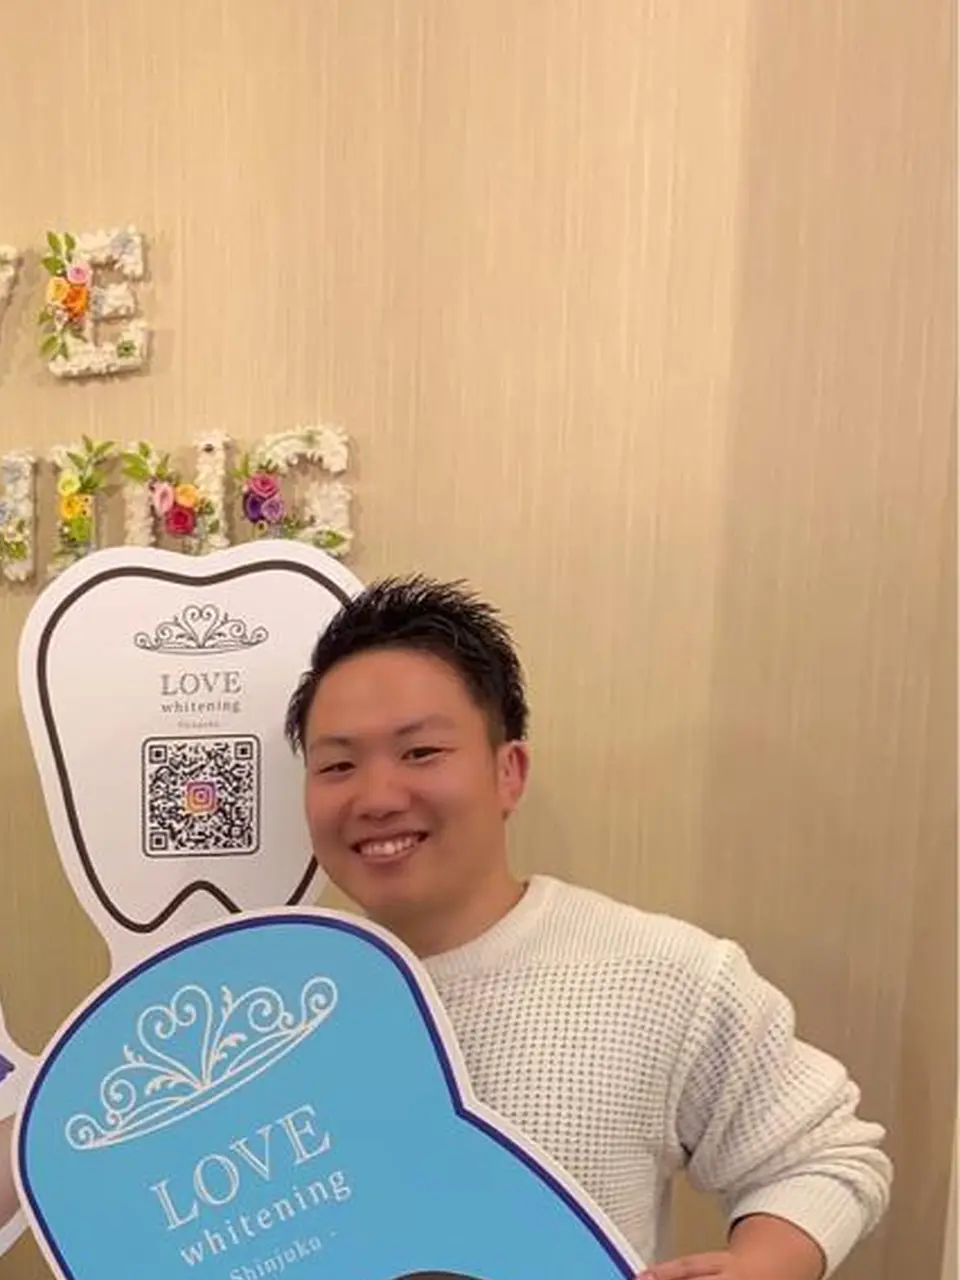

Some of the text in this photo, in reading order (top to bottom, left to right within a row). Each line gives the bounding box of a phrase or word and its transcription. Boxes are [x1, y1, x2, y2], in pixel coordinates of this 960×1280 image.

[160, 671, 243, 696] LOVE
[160, 699, 243, 715] whitening
[149, 1104, 333, 1232] LOVE
[179, 1169, 353, 1268] whitening
